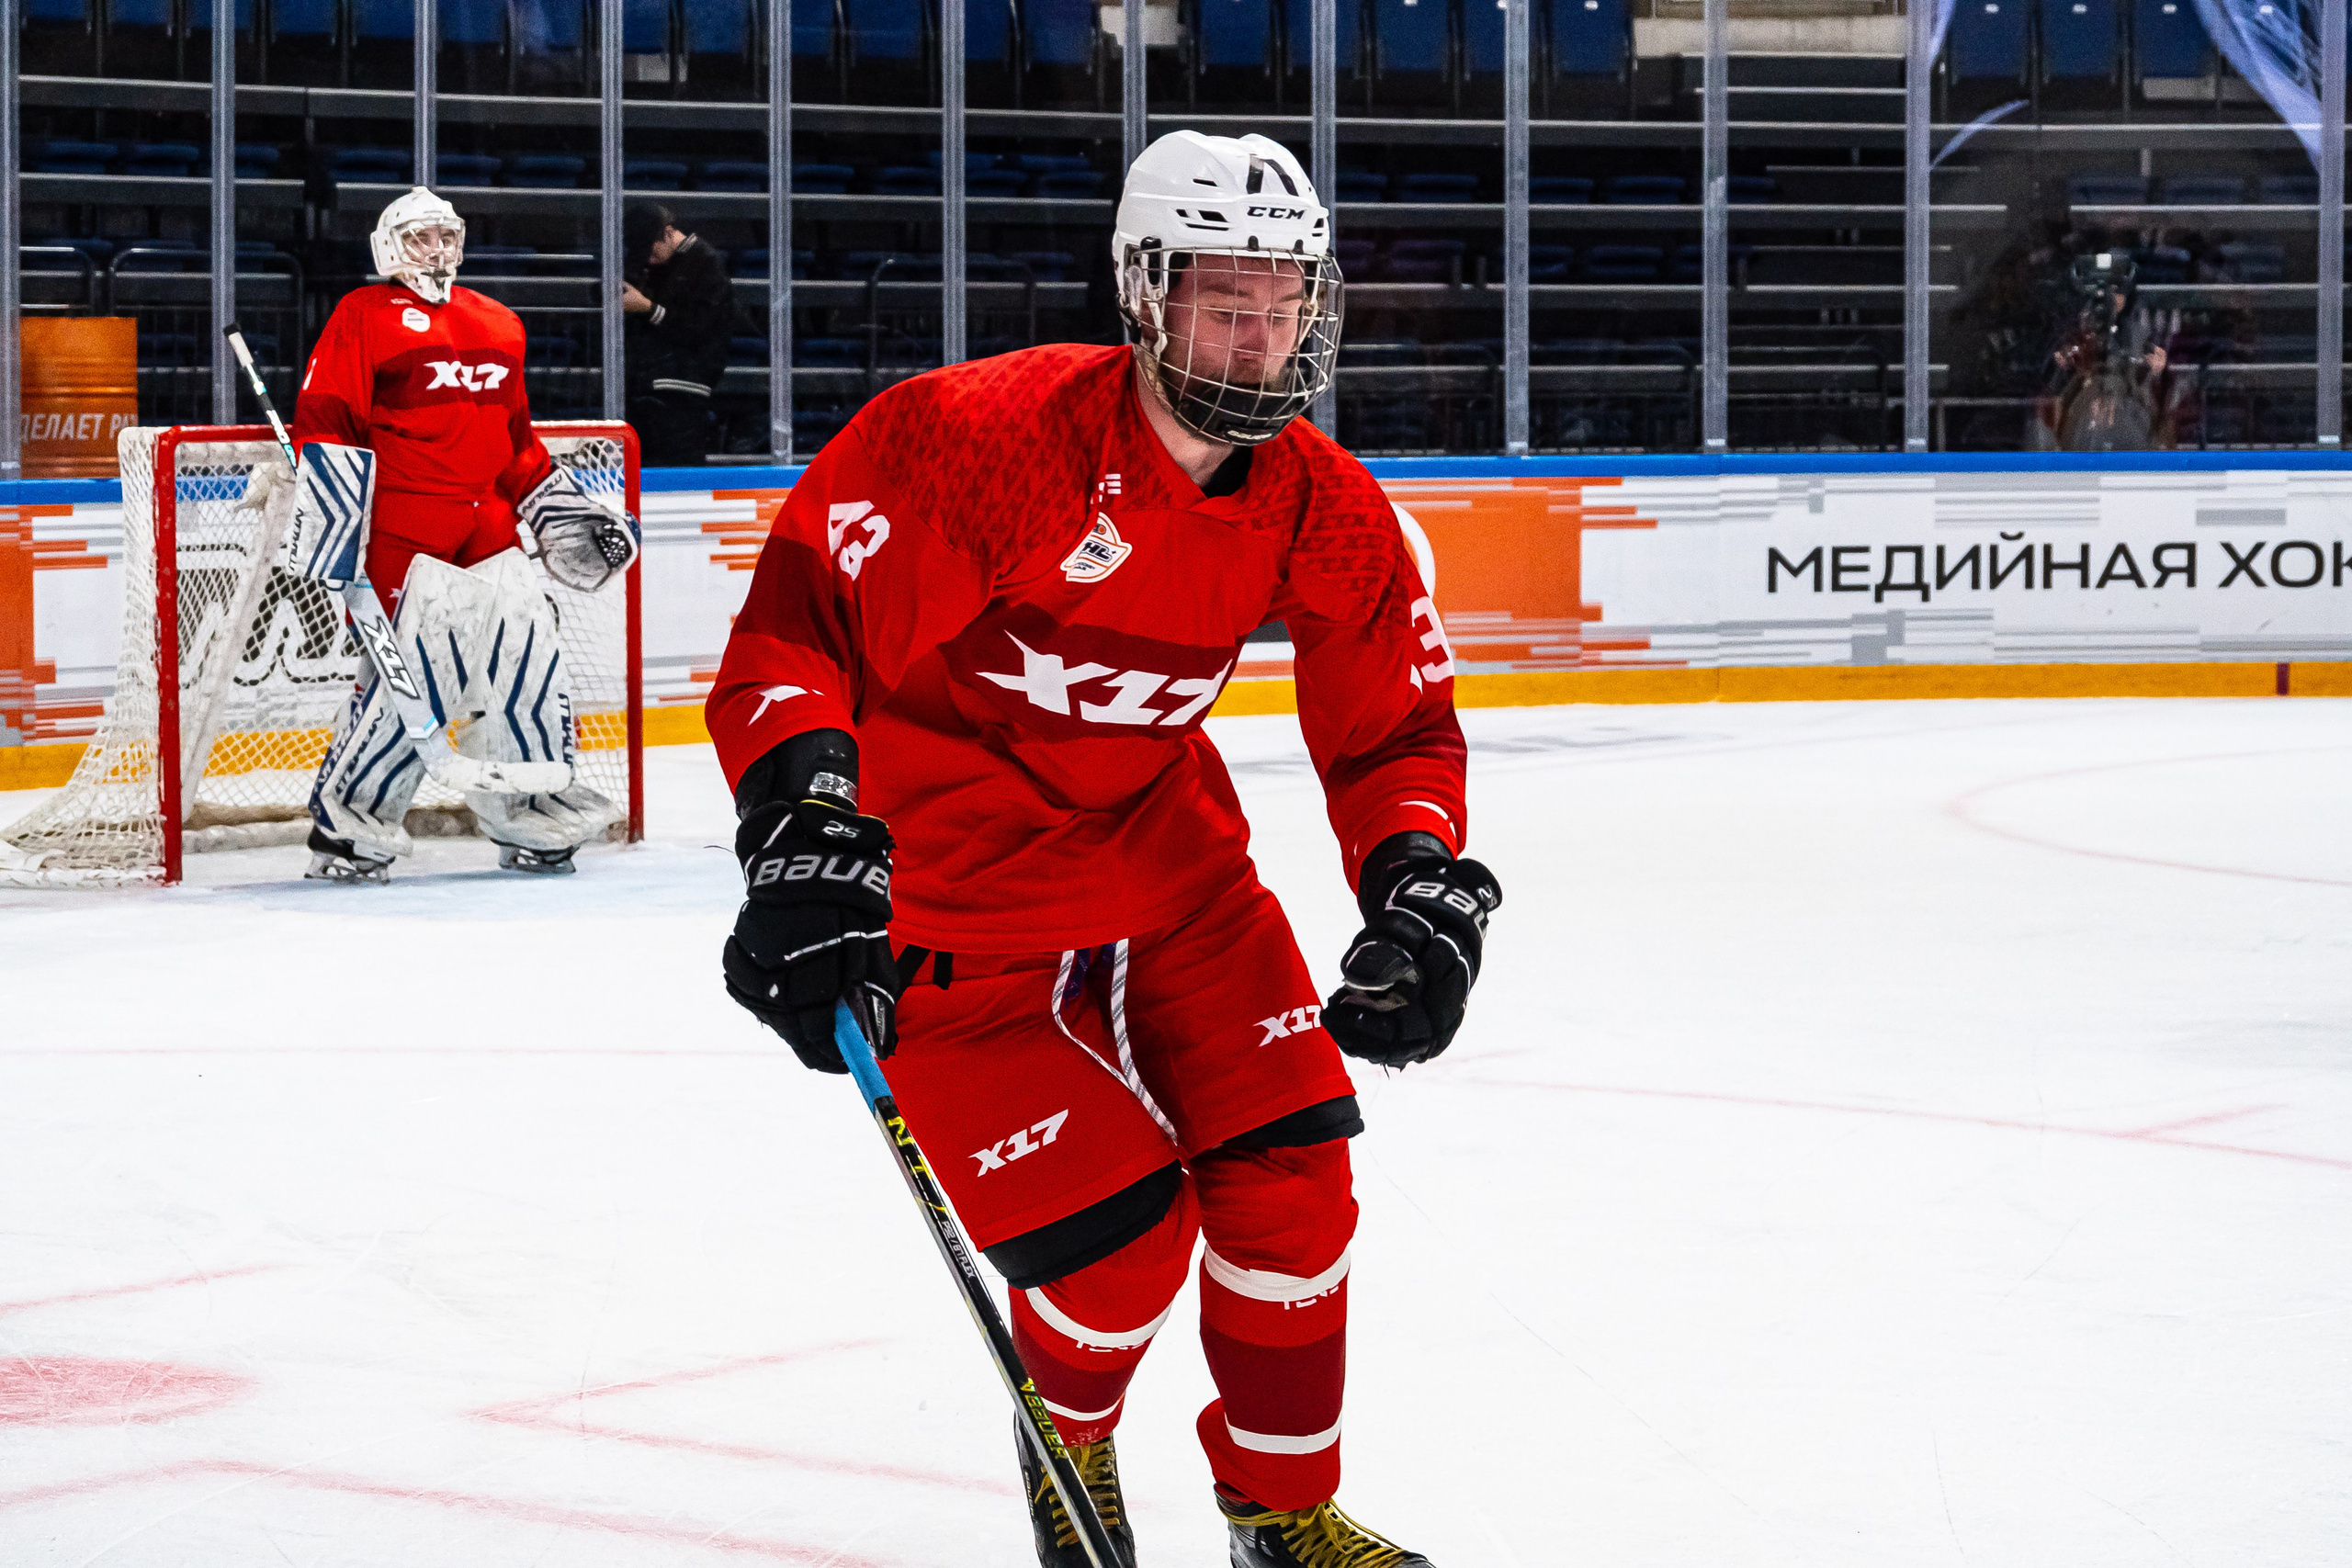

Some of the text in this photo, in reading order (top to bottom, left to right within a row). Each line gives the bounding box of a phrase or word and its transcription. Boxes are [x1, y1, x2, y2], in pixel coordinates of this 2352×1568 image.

[1247, 206, 1306, 220] CCM
[423, 360, 510, 392] X17
[108, 413, 137, 440] РА
[1767, 532, 2198, 603] МЕДИЙНАЯ
[359, 616, 422, 700] X17
[1409, 595, 1455, 695] 3
[975, 628, 1233, 726] X17
[752, 854, 890, 901] BAUE
[1253, 1004, 1322, 1047] X17
[967, 1108, 1069, 1178] X17
